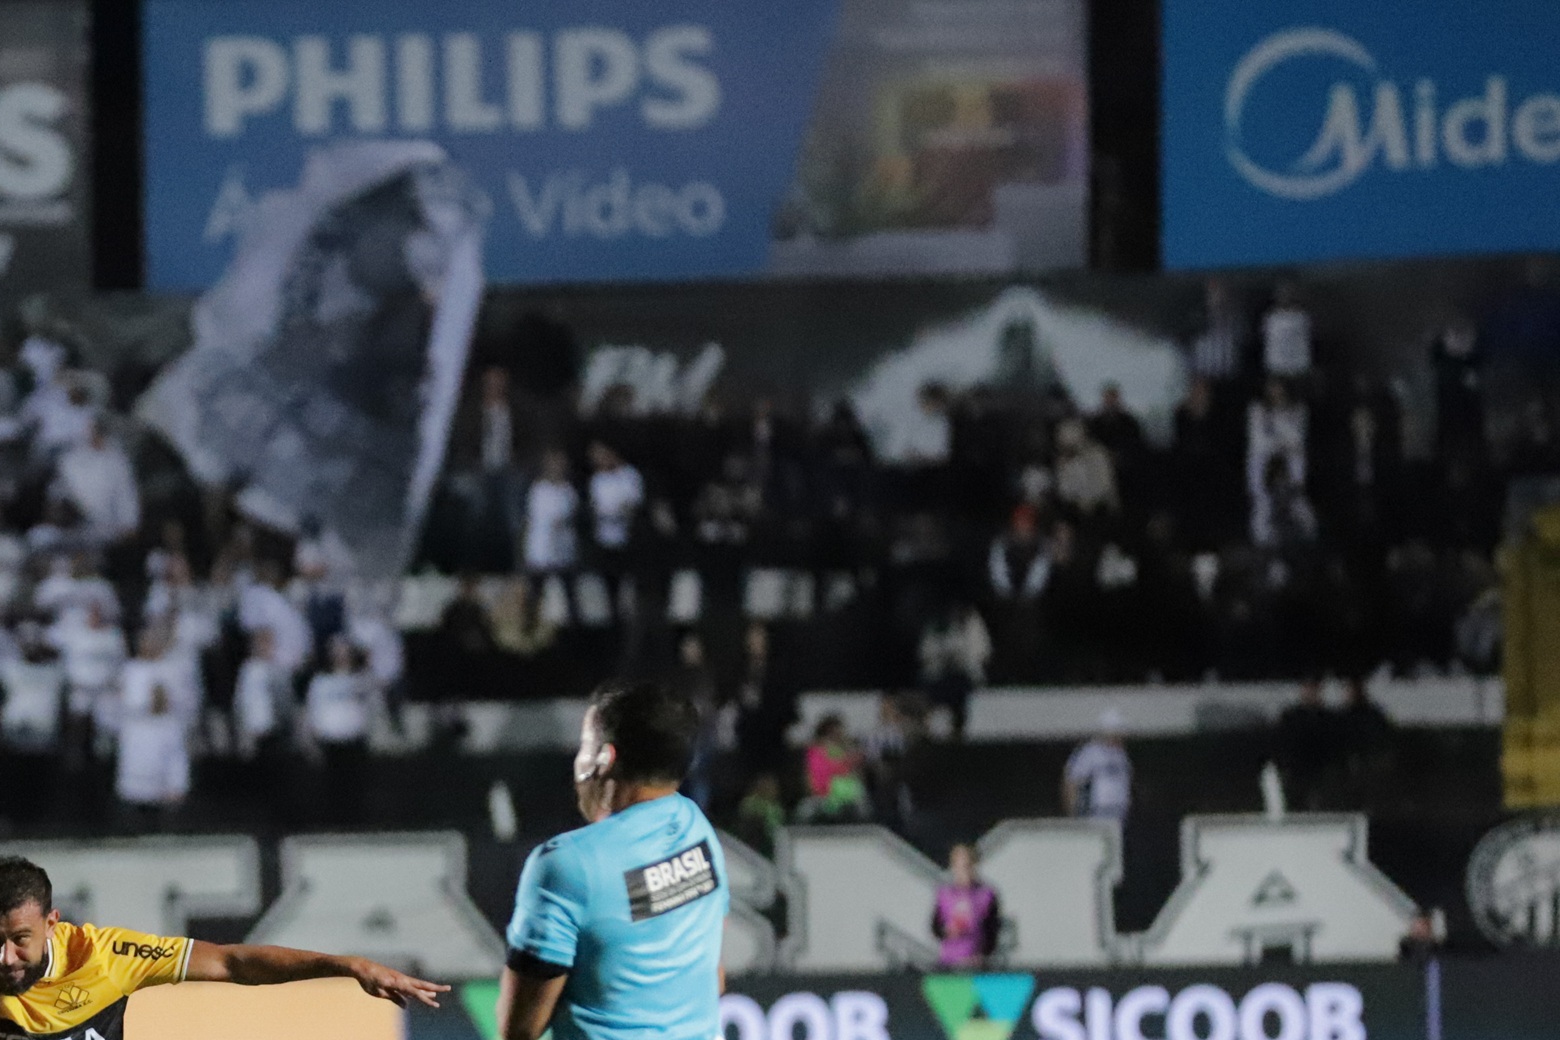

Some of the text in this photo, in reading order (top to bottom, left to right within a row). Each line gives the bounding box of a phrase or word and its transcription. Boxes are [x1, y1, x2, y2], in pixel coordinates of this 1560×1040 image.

[202, 25, 721, 137] PHILIPS
[1290, 74, 1560, 174] Mide
[643, 846, 710, 892] BRASIL
[112, 940, 175, 960] unesc
